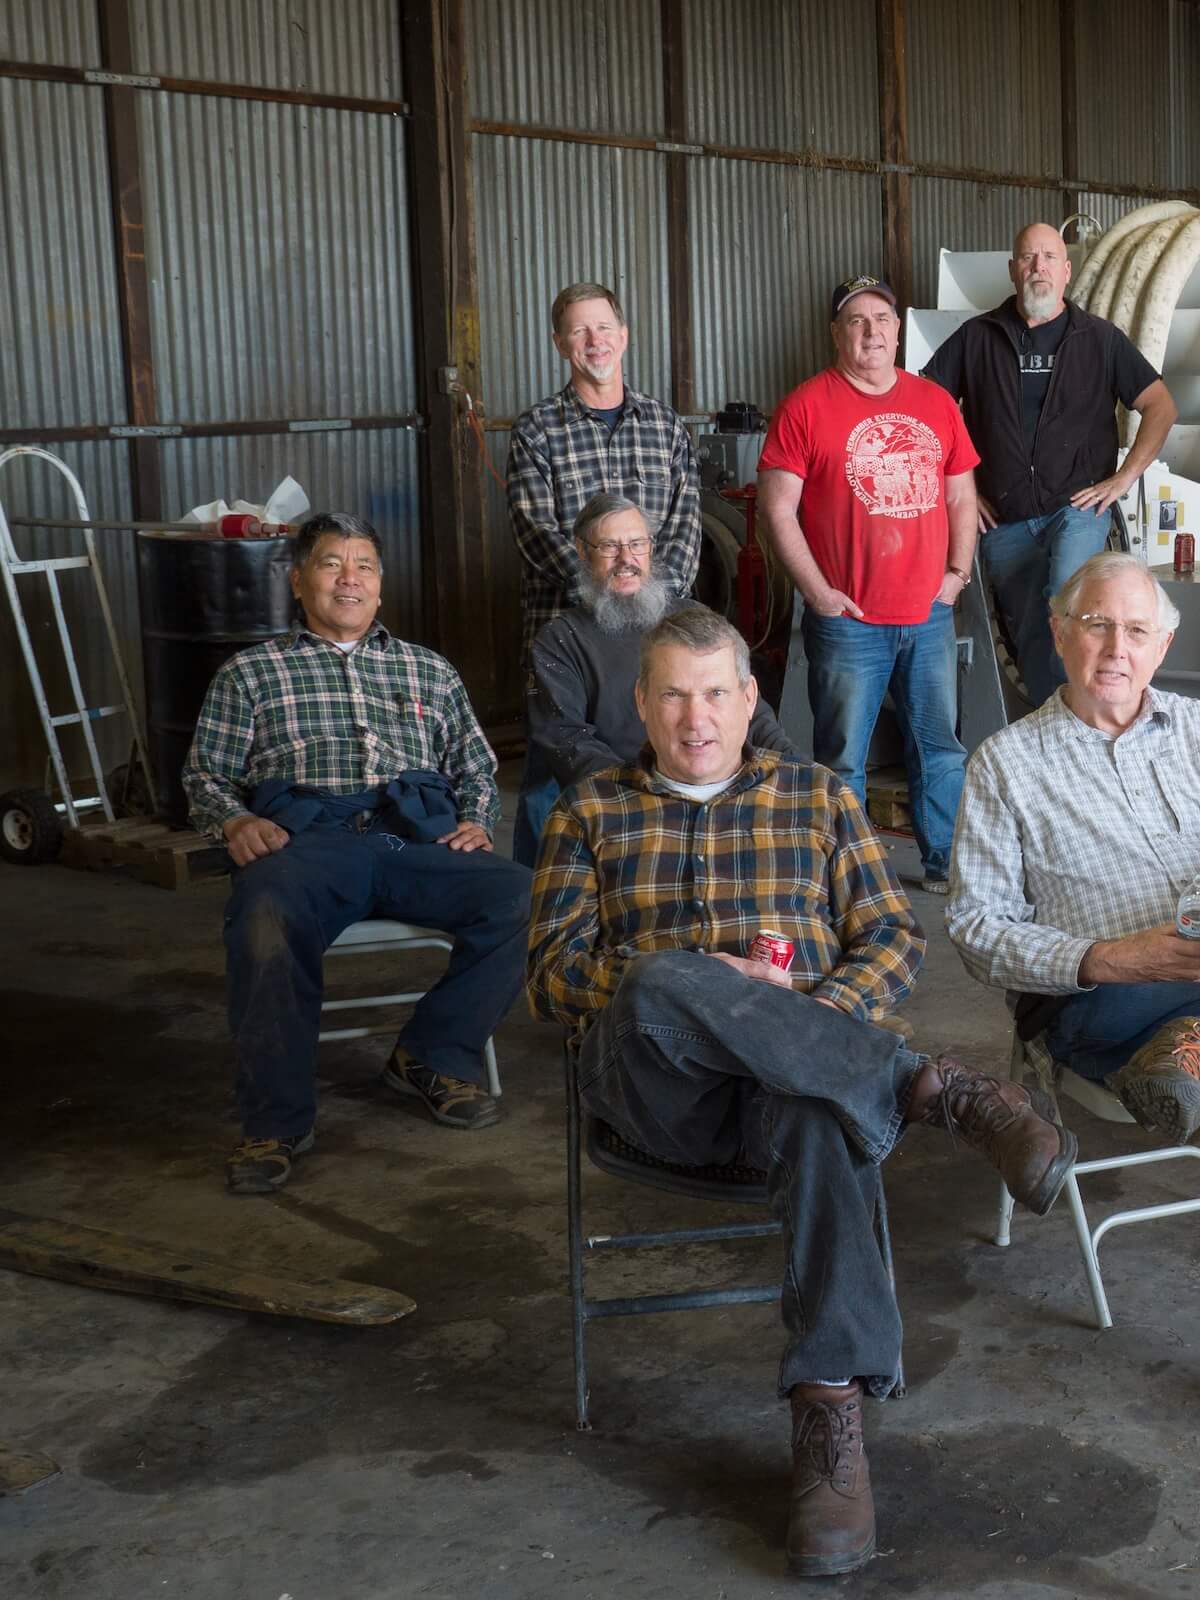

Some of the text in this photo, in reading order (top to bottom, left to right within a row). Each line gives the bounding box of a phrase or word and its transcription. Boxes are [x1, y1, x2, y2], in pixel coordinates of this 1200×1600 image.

[846, 412, 943, 462] REMEMBER EVERYONE DEPLOYED
[844, 461, 872, 506] DEPLOYED
